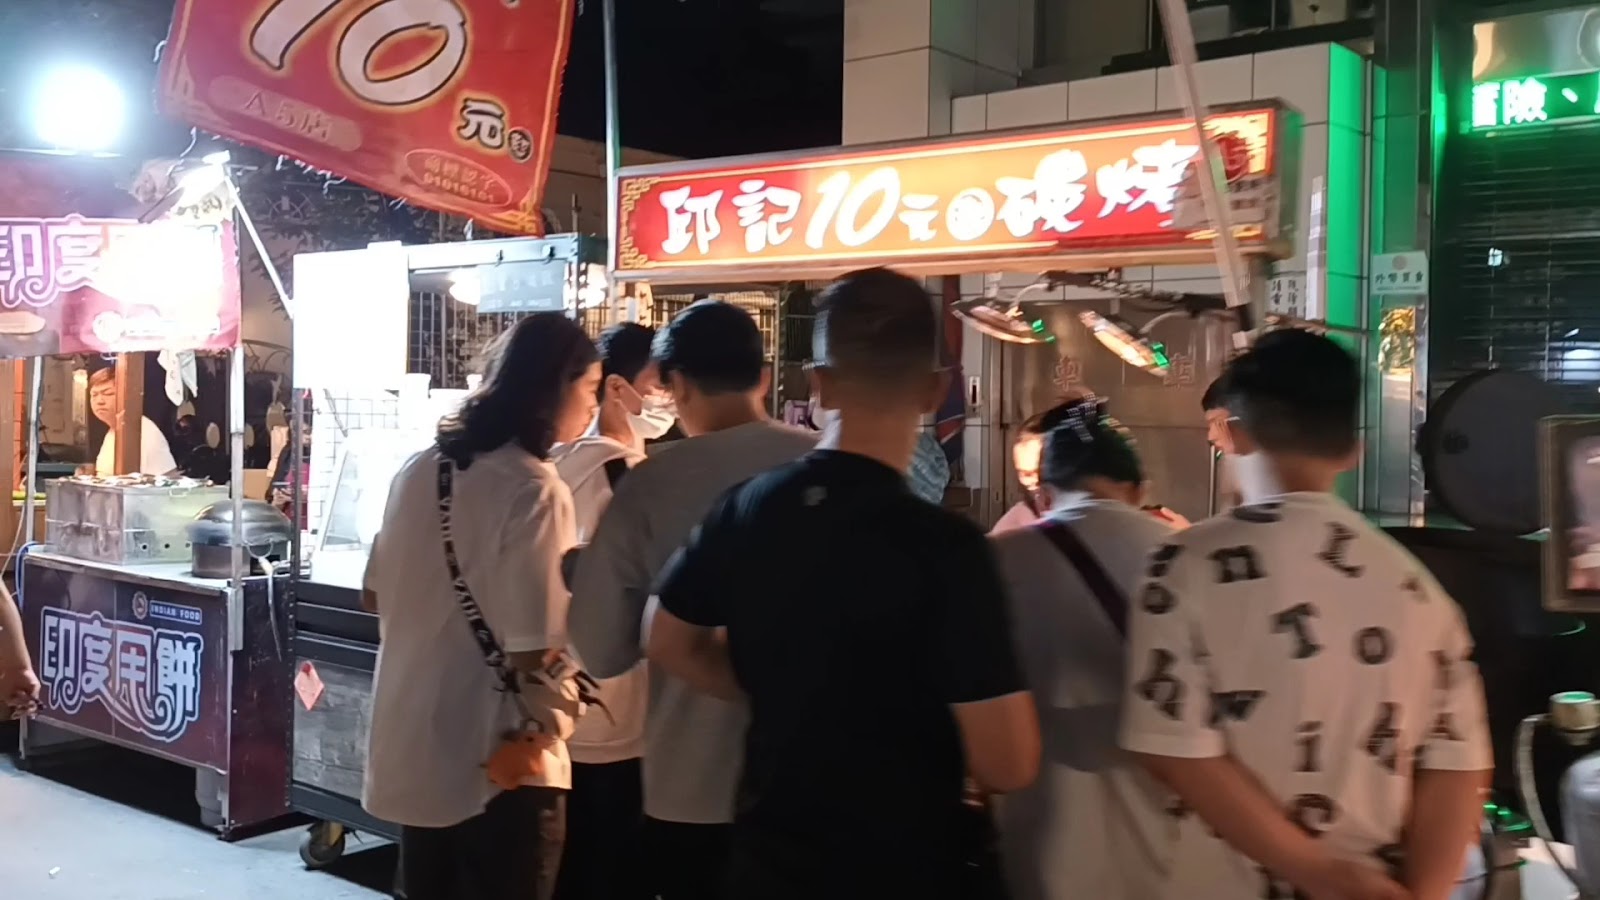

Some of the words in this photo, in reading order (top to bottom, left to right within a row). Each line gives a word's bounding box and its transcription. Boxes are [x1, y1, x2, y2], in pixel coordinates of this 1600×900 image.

[151, 605, 176, 617] INDIAN
[180, 609, 200, 621] FOOD
[42, 611, 201, 739] 印度甩餅
